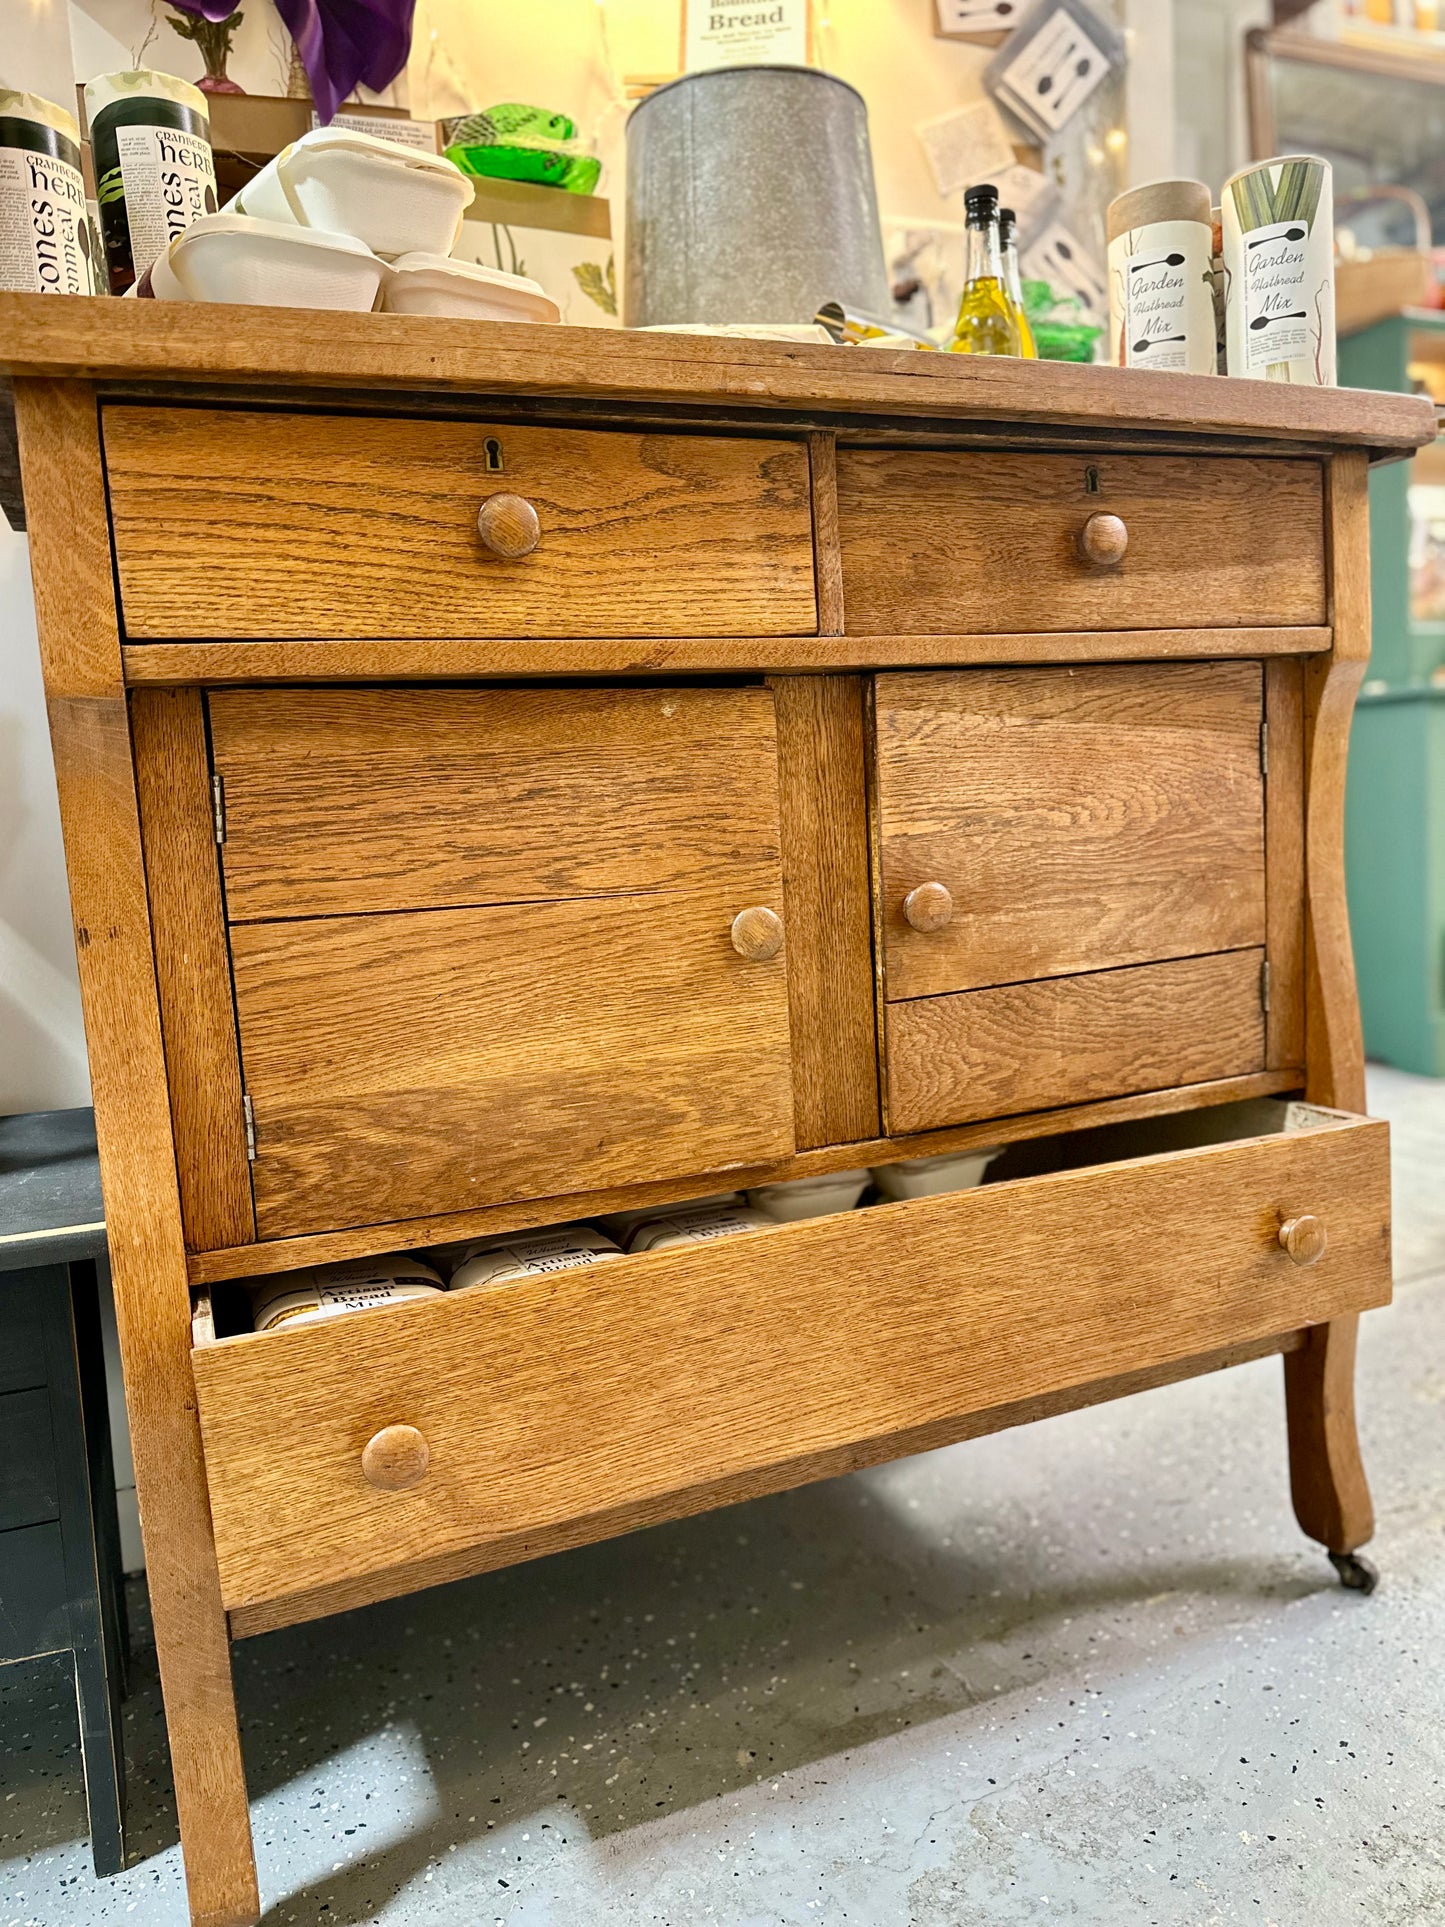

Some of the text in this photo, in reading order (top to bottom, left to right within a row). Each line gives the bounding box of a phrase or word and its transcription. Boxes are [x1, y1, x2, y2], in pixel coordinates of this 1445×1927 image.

[709, 6, 783, 31] Bread
[26, 155, 83, 189] CRANBERR
[1249, 247, 1305, 277] Garden
[1131, 271, 1185, 299] Garden
[1259, 292, 1293, 315] Mix
[1141, 316, 1172, 337] Mix
[700, 1224, 748, 1237] Bread
[522, 1253, 593, 1269] Artisan
[540, 1258, 592, 1273] Bread
[320, 1285, 395, 1298] Artisan
[331, 1290, 392, 1304] Bread
[345, 1301, 384, 1309] Mix
